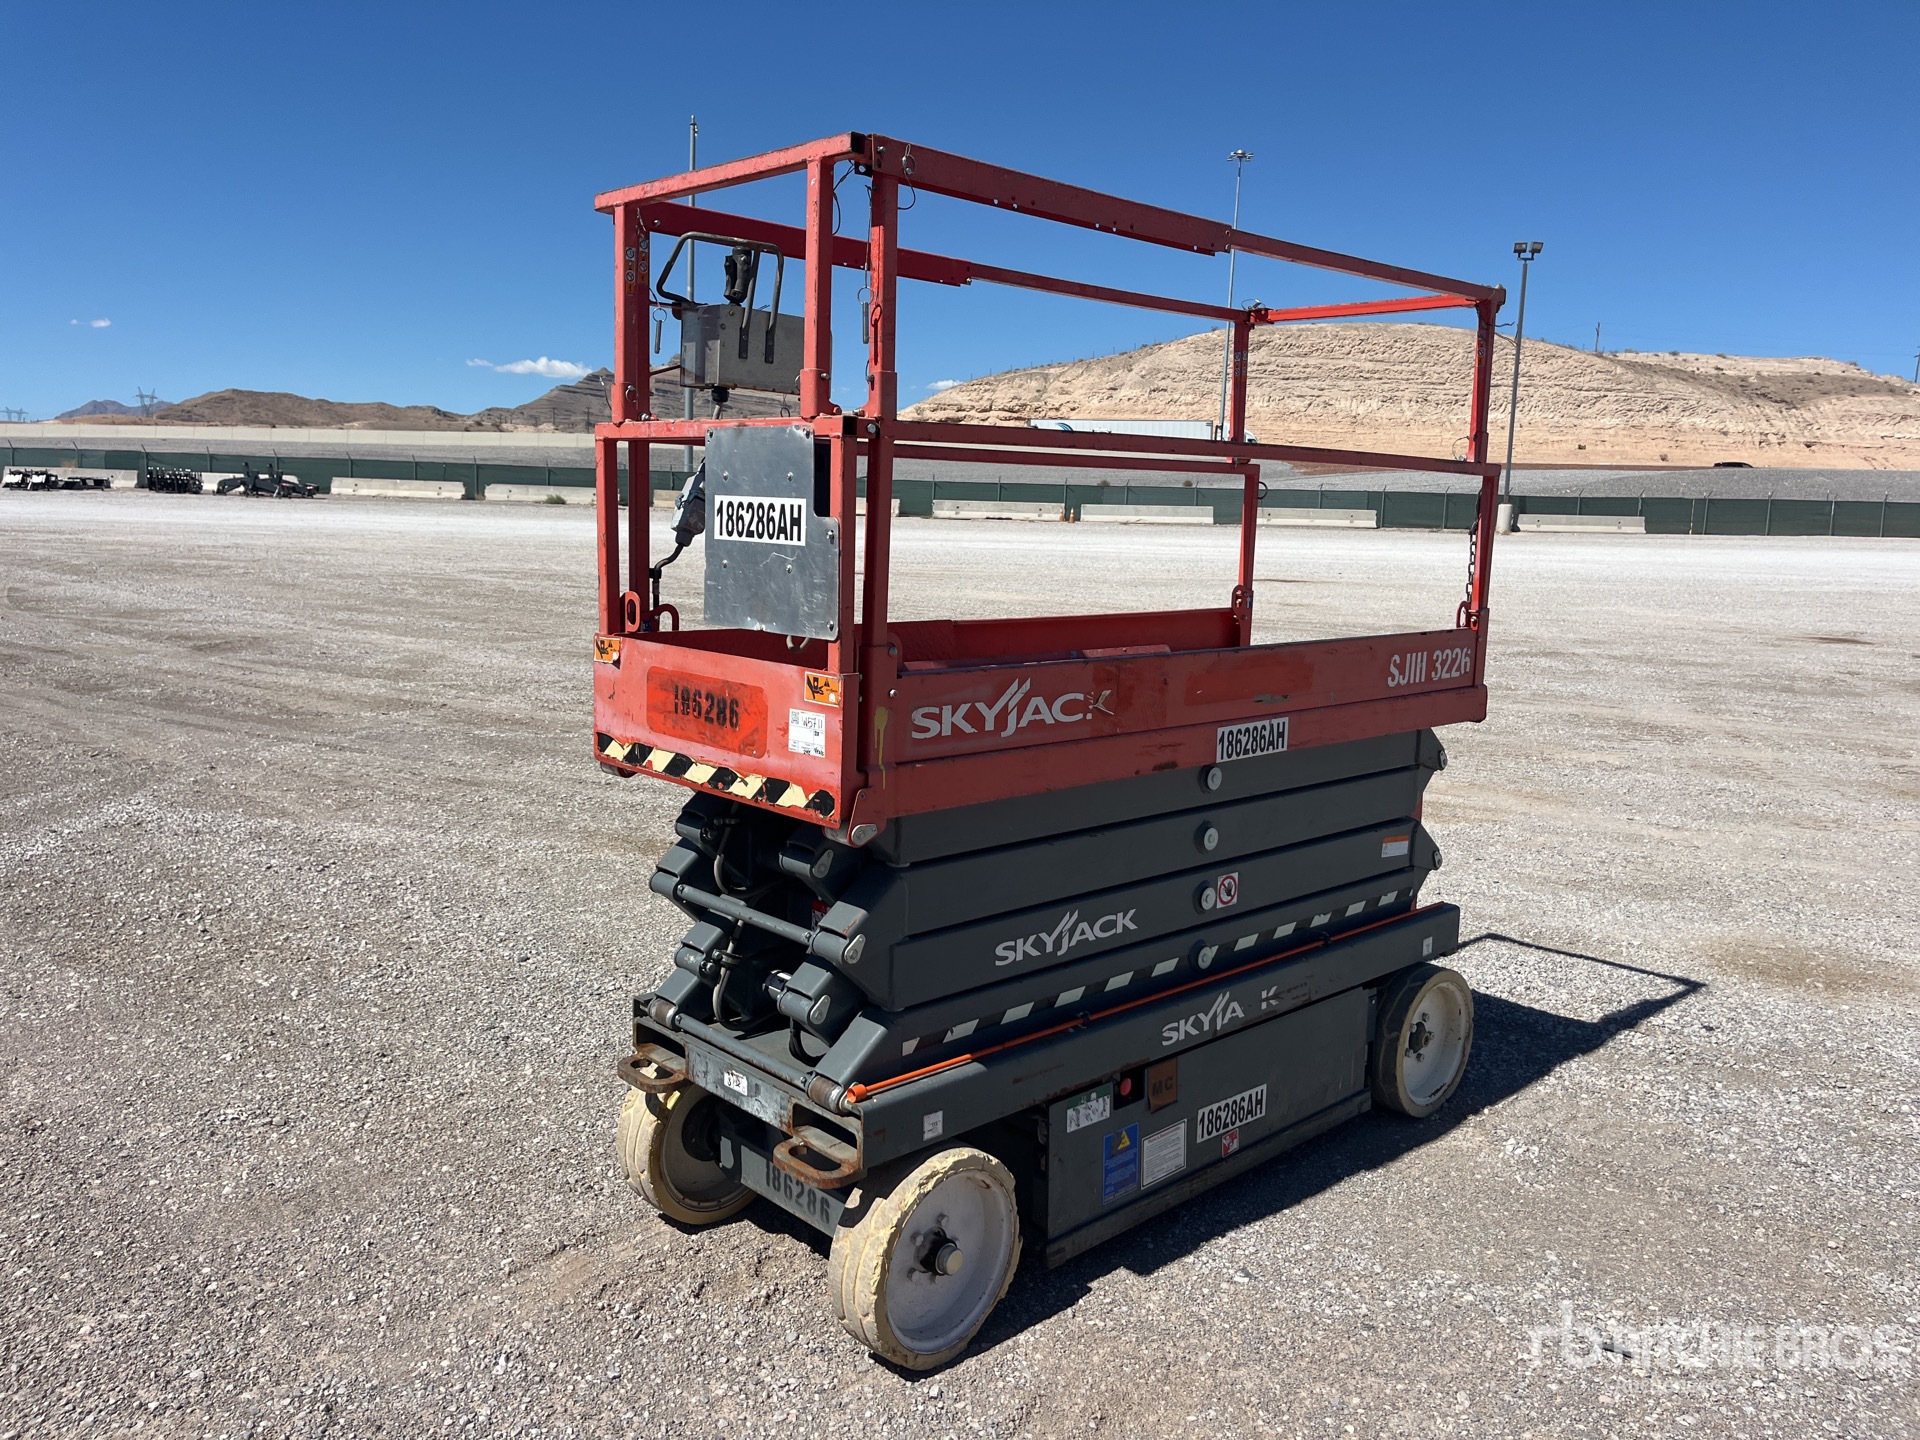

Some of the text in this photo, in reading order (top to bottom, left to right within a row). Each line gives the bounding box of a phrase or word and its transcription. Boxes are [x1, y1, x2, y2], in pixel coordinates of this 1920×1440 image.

[717, 500, 802, 542] 186286AH
[1431, 647, 1471, 680] 3226
[674, 685, 739, 730] 186286
[1218, 721, 1286, 760] 186286AH
[994, 908, 1138, 966] SKYJACK
[1161, 986, 1280, 1046] SKYJAK
[1152, 1076, 1174, 1097] MC
[1199, 1089, 1264, 1140] 186286AH
[766, 1160, 830, 1225] 186286
